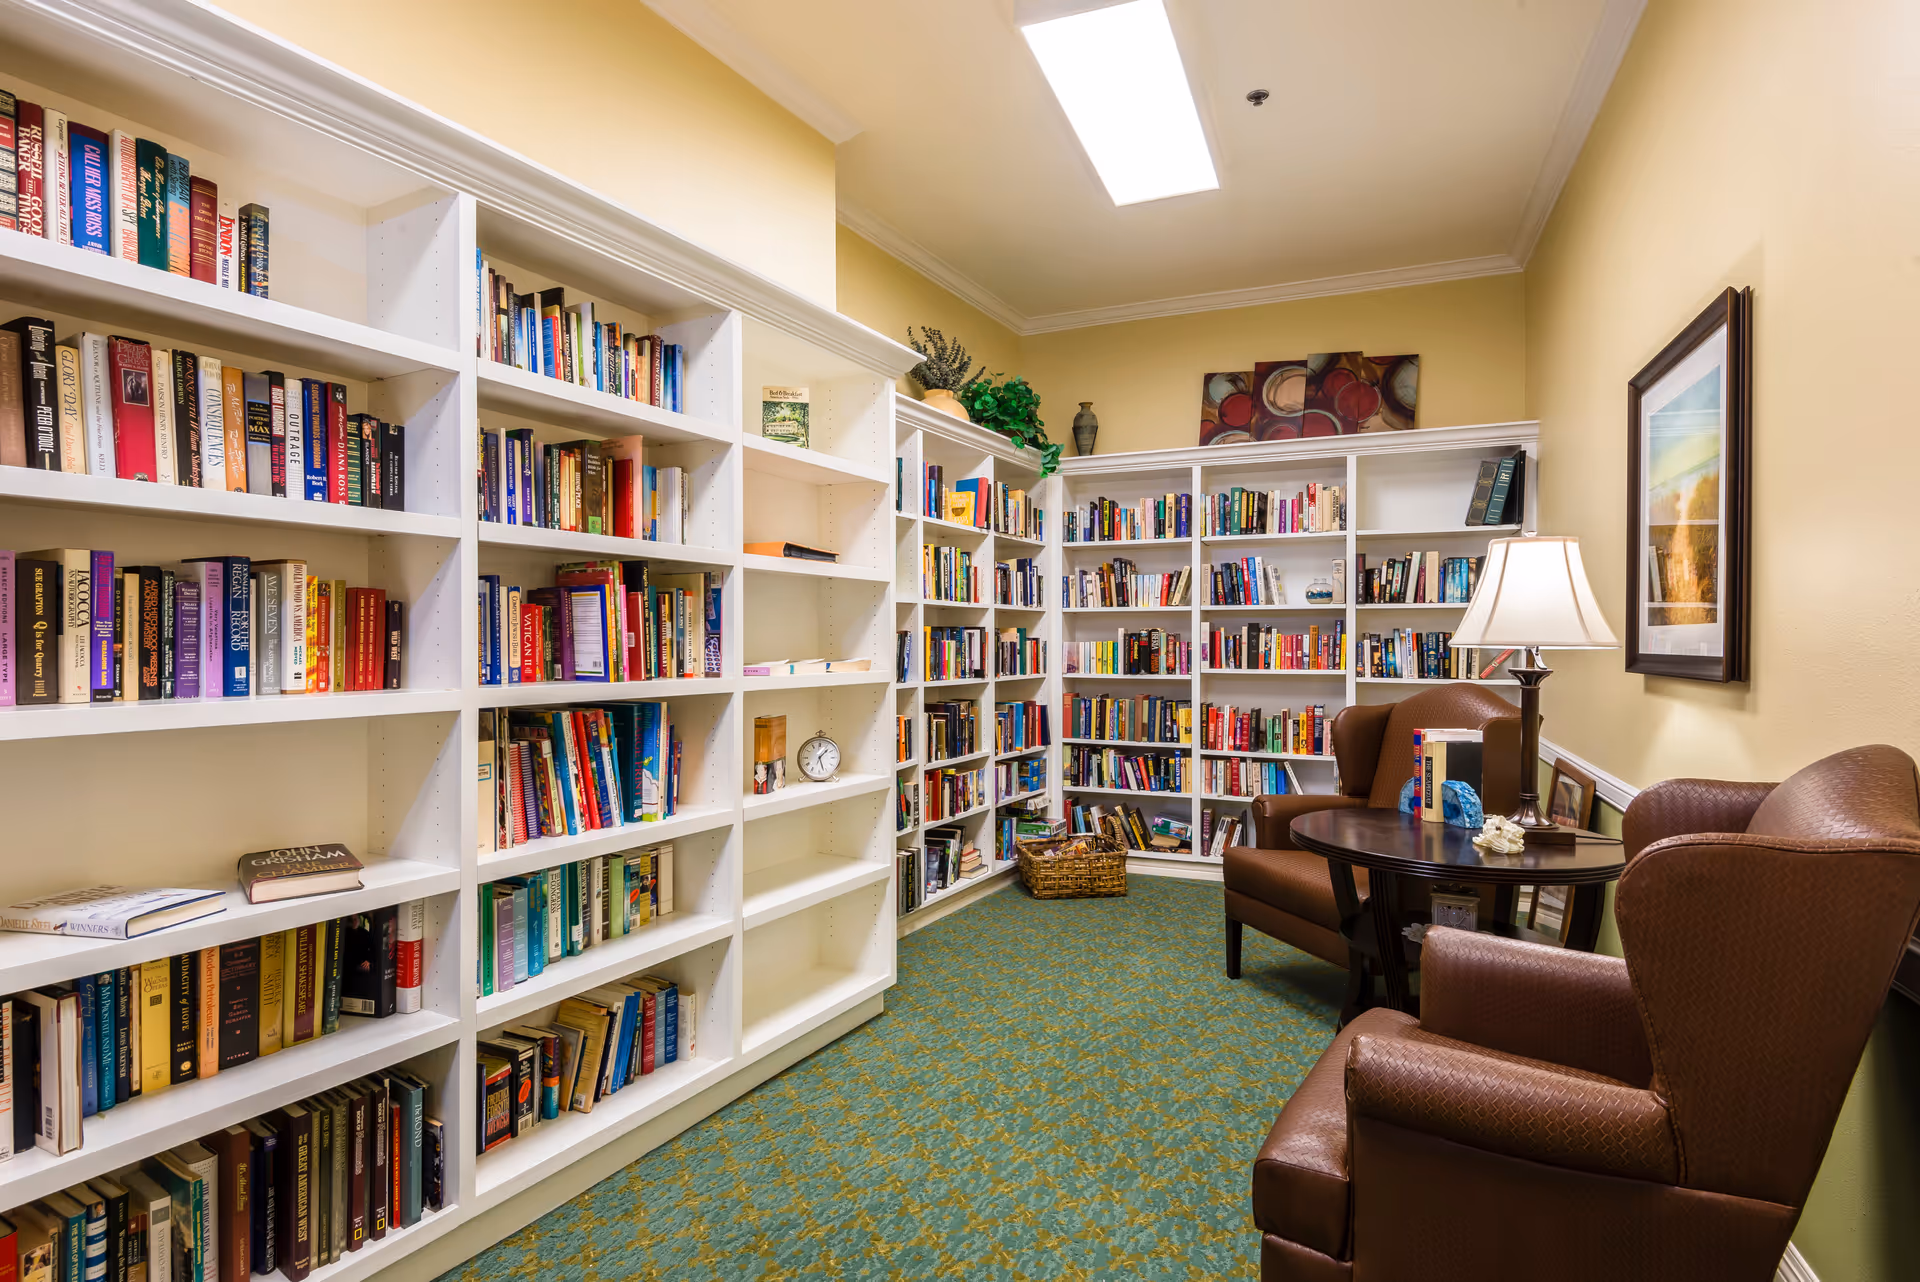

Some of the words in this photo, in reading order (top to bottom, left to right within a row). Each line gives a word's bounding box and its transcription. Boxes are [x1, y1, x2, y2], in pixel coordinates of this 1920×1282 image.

[18, 126, 30, 172] BAKER
[31, 124, 42, 180] RUSSELL
[84, 144, 101, 166] CALL
[86, 165, 101, 186] HER
[120, 135, 136, 193] AUTOBIOGRAPHY
[178, 161, 189, 204] BORMAN
[86, 186, 101, 211] MISS
[140, 196, 151, 219] Peters
[31, 196, 42, 236] GOOD
[86, 210, 102, 237] ROSS
[122, 209, 137, 226] SPY
[218, 214, 236, 258] LYNDON
[117, 341, 150, 356] PETER
[117, 354, 150, 367] GREAT
[60, 349, 76, 391] GLORY
[175, 354, 183, 377] MADGE
[158, 382, 166, 408] PARSON
[177, 379, 185, 405] LORWIN
[272, 386, 284, 405] RUSH
[37, 405, 52, 426] PETER
[63, 392, 77, 421] DAY
[159, 409, 167, 432] HENRY
[205, 388, 224, 467] CONSEQUENCES
[248, 424, 270, 434] MAX
[272, 404, 284, 437] LIMBAUGH
[312, 414, 321, 438] TOWARDS
[38, 426, 54, 453] O'TOOLE
[160, 432, 168, 460] RENFRO
[189, 420, 200, 450] William
[289, 413, 300, 465] OUTRAGE
[337, 441, 345, 471] DIANA
[338, 474, 346, 497] ROSS
[34, 568, 43, 582] SUE
[68, 569, 75, 580] AN
[232, 563, 242, 599] REGAN
[267, 575, 277, 596] WE
[293, 564, 303, 603] HOLLYWOOD
[35, 583, 43, 616] GRAFTON
[77, 569, 90, 629] IACOCCA
[149, 579, 159, 607] ALFRED
[33, 620, 48, 630] Q
[150, 607, 158, 651] HITCHCOCK
[241, 610, 249, 630] FOR
[267, 598, 277, 635] SEVEN
[294, 613, 303, 642] AMERICA
[231, 610, 241, 651] RECORD
[241, 630, 249, 651] THE
[390, 630, 398, 645] WILD
[524, 613, 532, 656] VATICAN
[1151, 631, 1159, 650] IBERIA
[35, 639, 45, 651] for
[390, 646, 398, 661] WEST
[33, 651, 45, 678] Quarry
[149, 652, 158, 687] PRESENTS
[634, 717, 642, 758] LARGE
[634, 761, 642, 798] PRINT
[251, 850, 346, 866] GRISHAM
[269, 845, 321, 858] JOHN
[256, 862, 352, 878] CHAMBER
[0, 916, 29, 929] DANIELLE
[31, 918, 50, 930] STEEL
[69, 922, 110, 934] WINNERS
[300, 929, 308, 964] WILLIAM
[181, 953, 189, 995] AUDACITY
[206, 949, 215, 984] Modern
[101, 986, 111, 1000] MY
[263, 974, 275, 1006] SMITH
[298, 965, 307, 1015] SHAKESPEARE
[101, 1000, 110, 1035] PROSTATE
[120, 996, 128, 1017] MONEY
[206, 983, 216, 1027] Petroleum
[181, 1007, 189, 1032] HOPE
[102, 1036, 110, 1052] AND
[176, 1044, 194, 1053] OBAMA
[103, 1052, 111, 1067] ME
[120, 1046, 128, 1078] RUKEYSER
[298, 1145, 307, 1173] GREAT
[202, 1182, 210, 1196] THE
[298, 1174, 308, 1218] AMERICAN
[202, 1198, 210, 1234] AMERICAN
[298, 1218, 308, 1243] WEST
